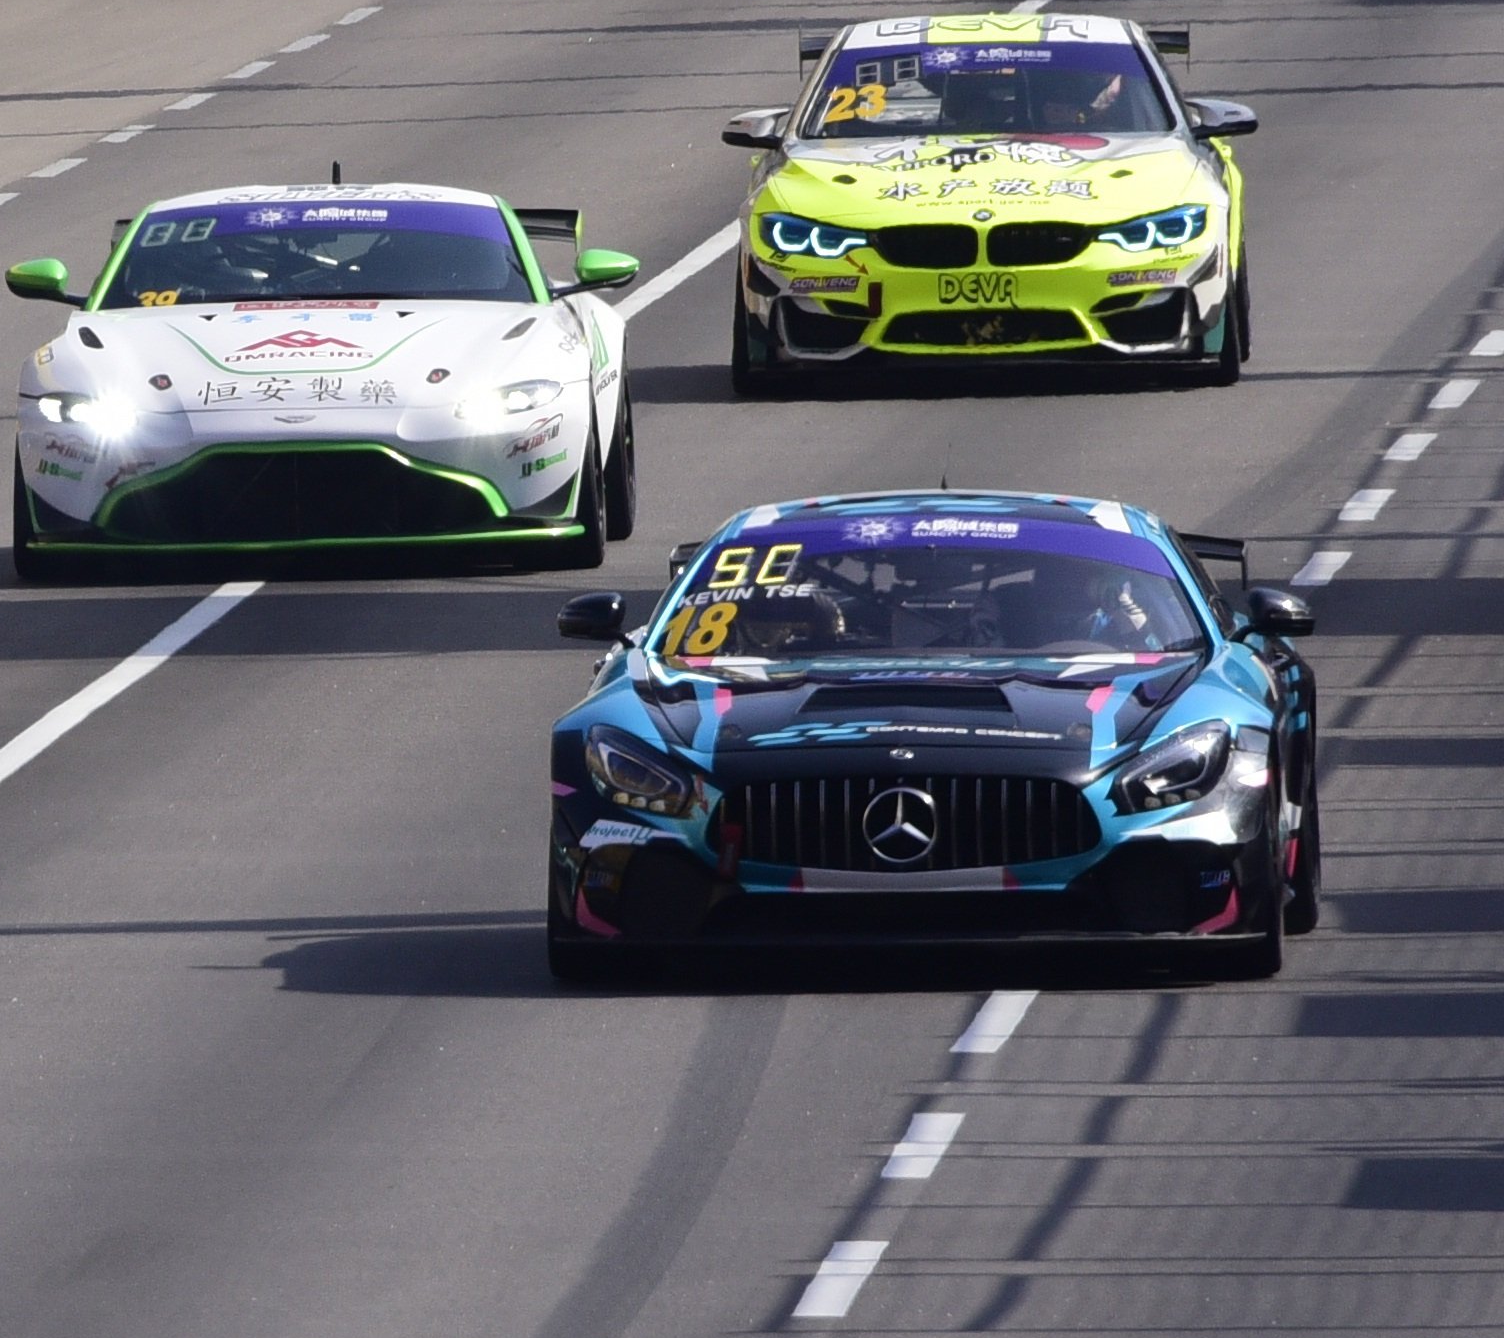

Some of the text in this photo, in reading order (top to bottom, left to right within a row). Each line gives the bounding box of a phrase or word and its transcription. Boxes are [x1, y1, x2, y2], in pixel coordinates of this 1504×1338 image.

[824, 84, 887, 123] 23
[938, 273, 1018, 309] DEVA
[678, 583, 816, 608] KEVIN TSE
[662, 602, 739, 656] 18
[866, 725, 1063, 740] CONTEMPO CONCEPT
